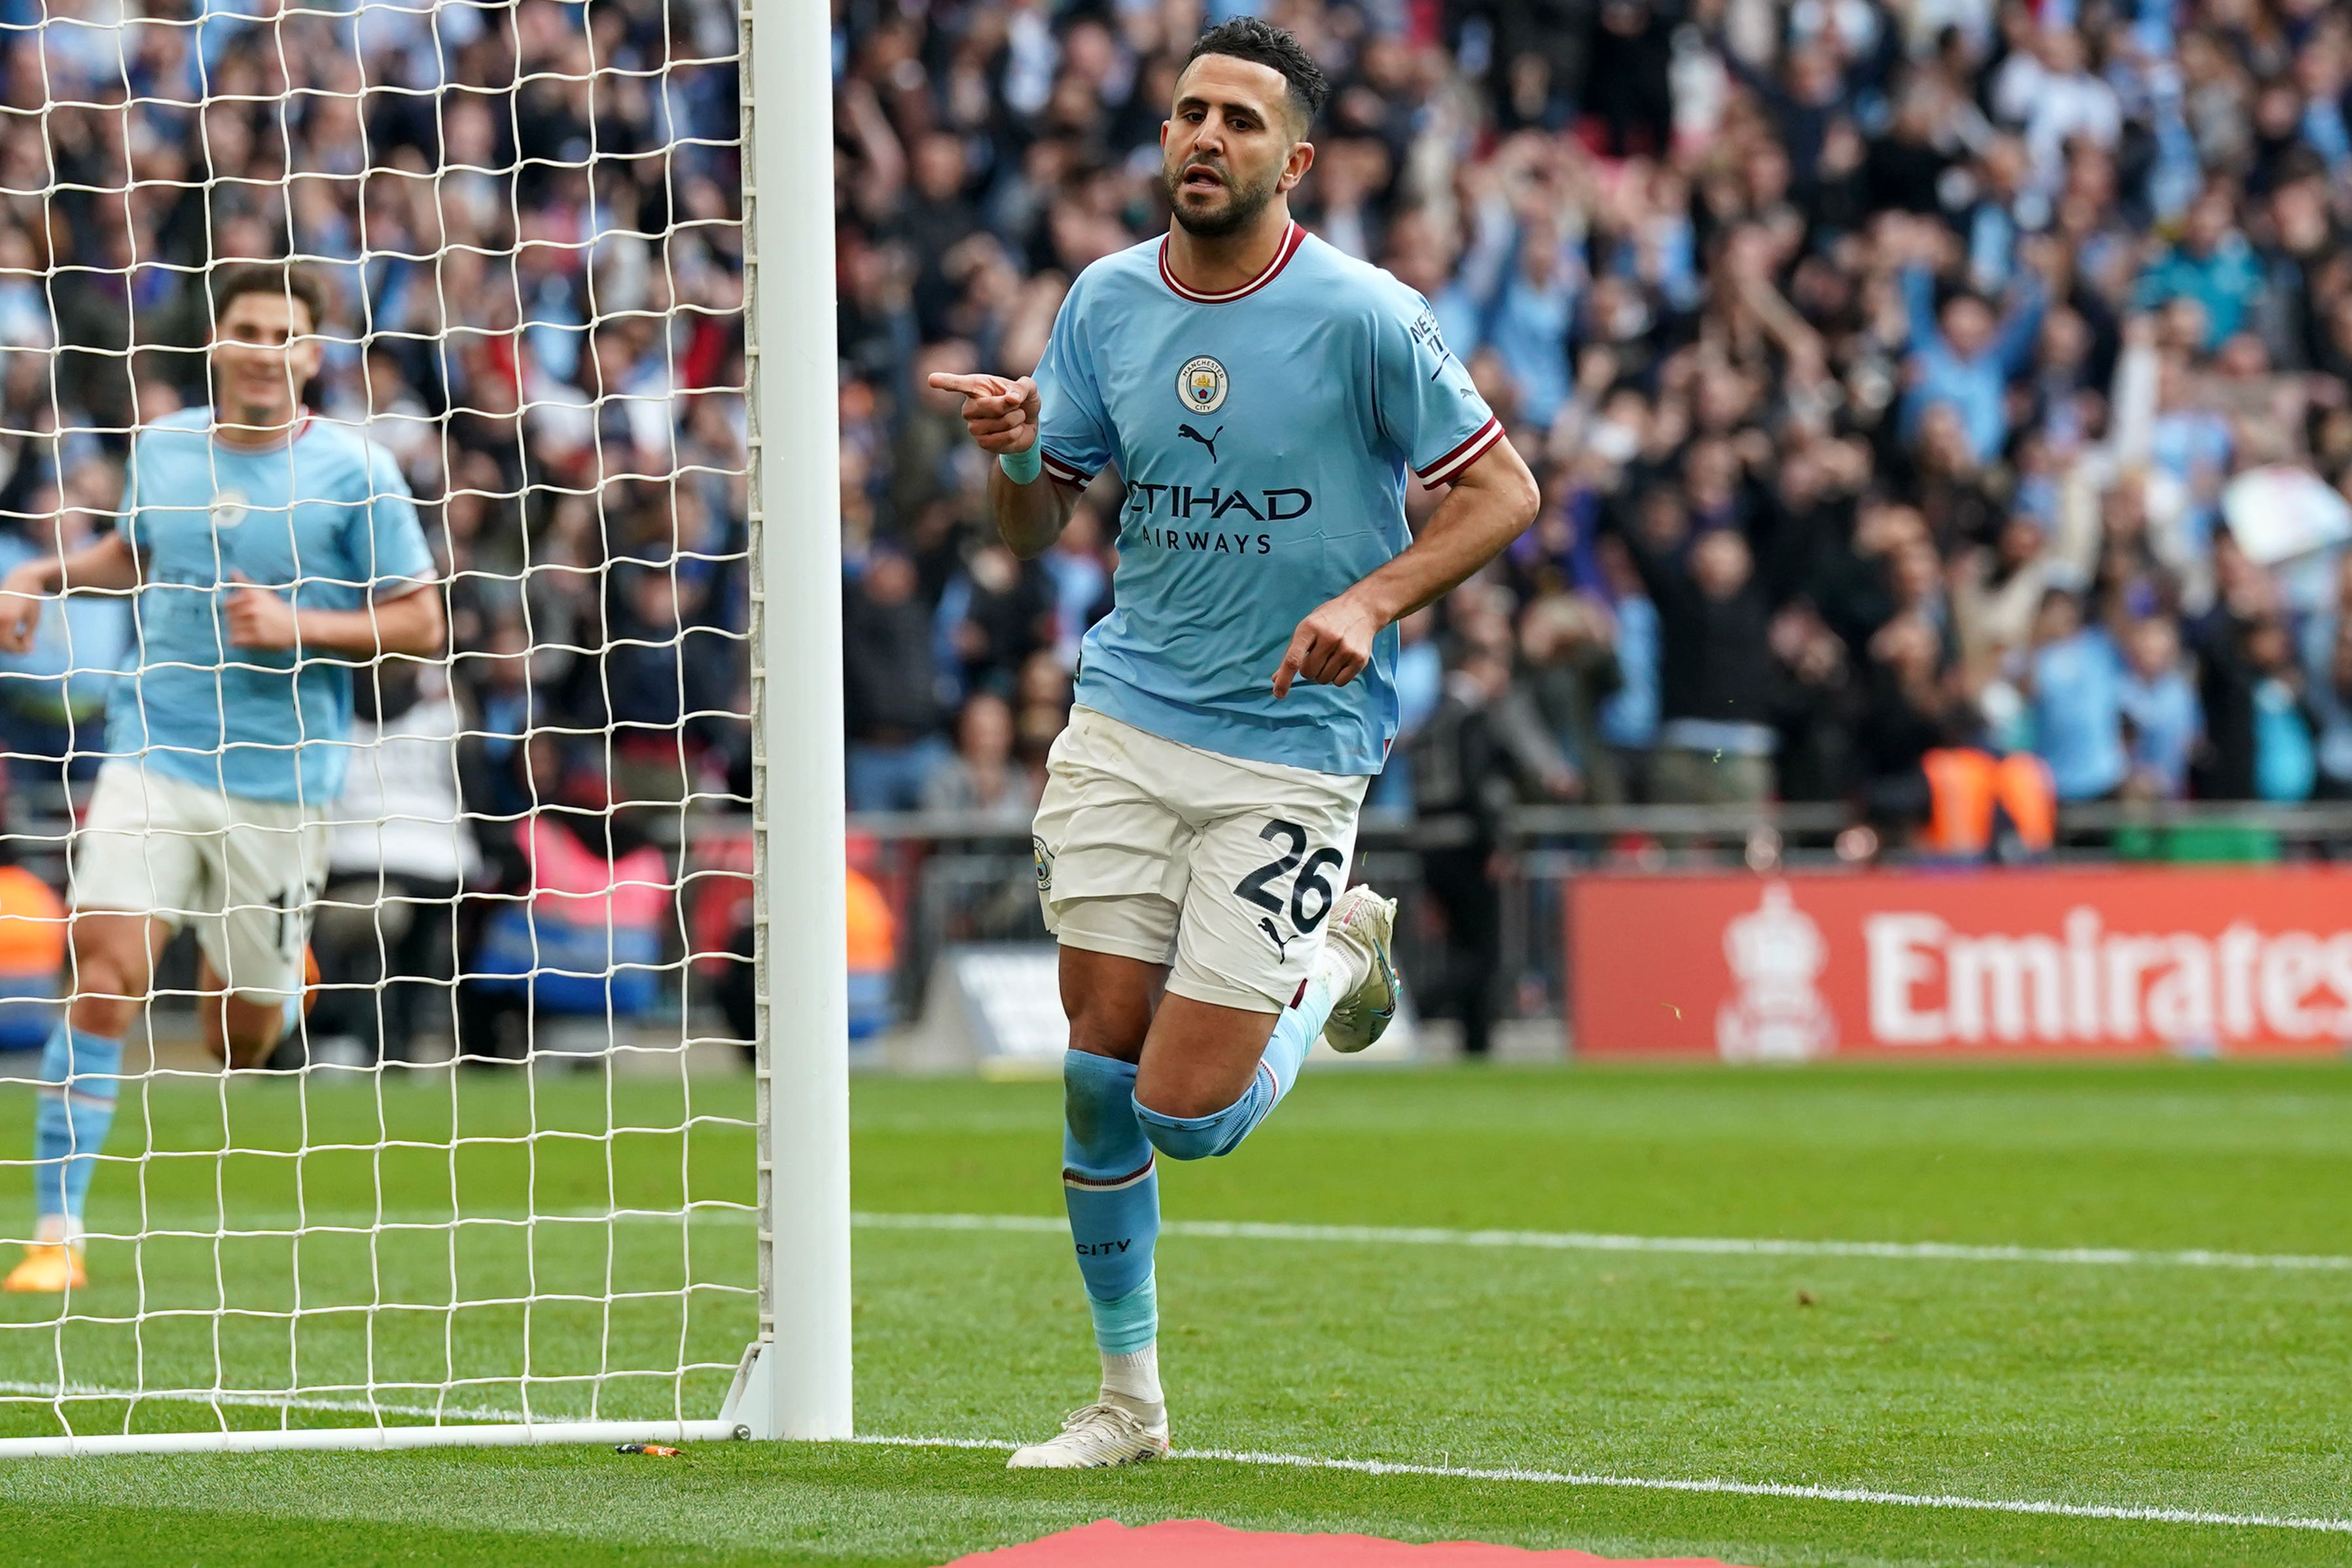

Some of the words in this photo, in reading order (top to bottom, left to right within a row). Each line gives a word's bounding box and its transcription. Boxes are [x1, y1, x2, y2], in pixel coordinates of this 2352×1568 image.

[1183, 360, 1224, 379] MANCHESTER
[1143, 526, 1270, 554] AIRWAYS
[1233, 819, 1344, 935] 26
[1076, 1238, 1131, 1256] CITY
